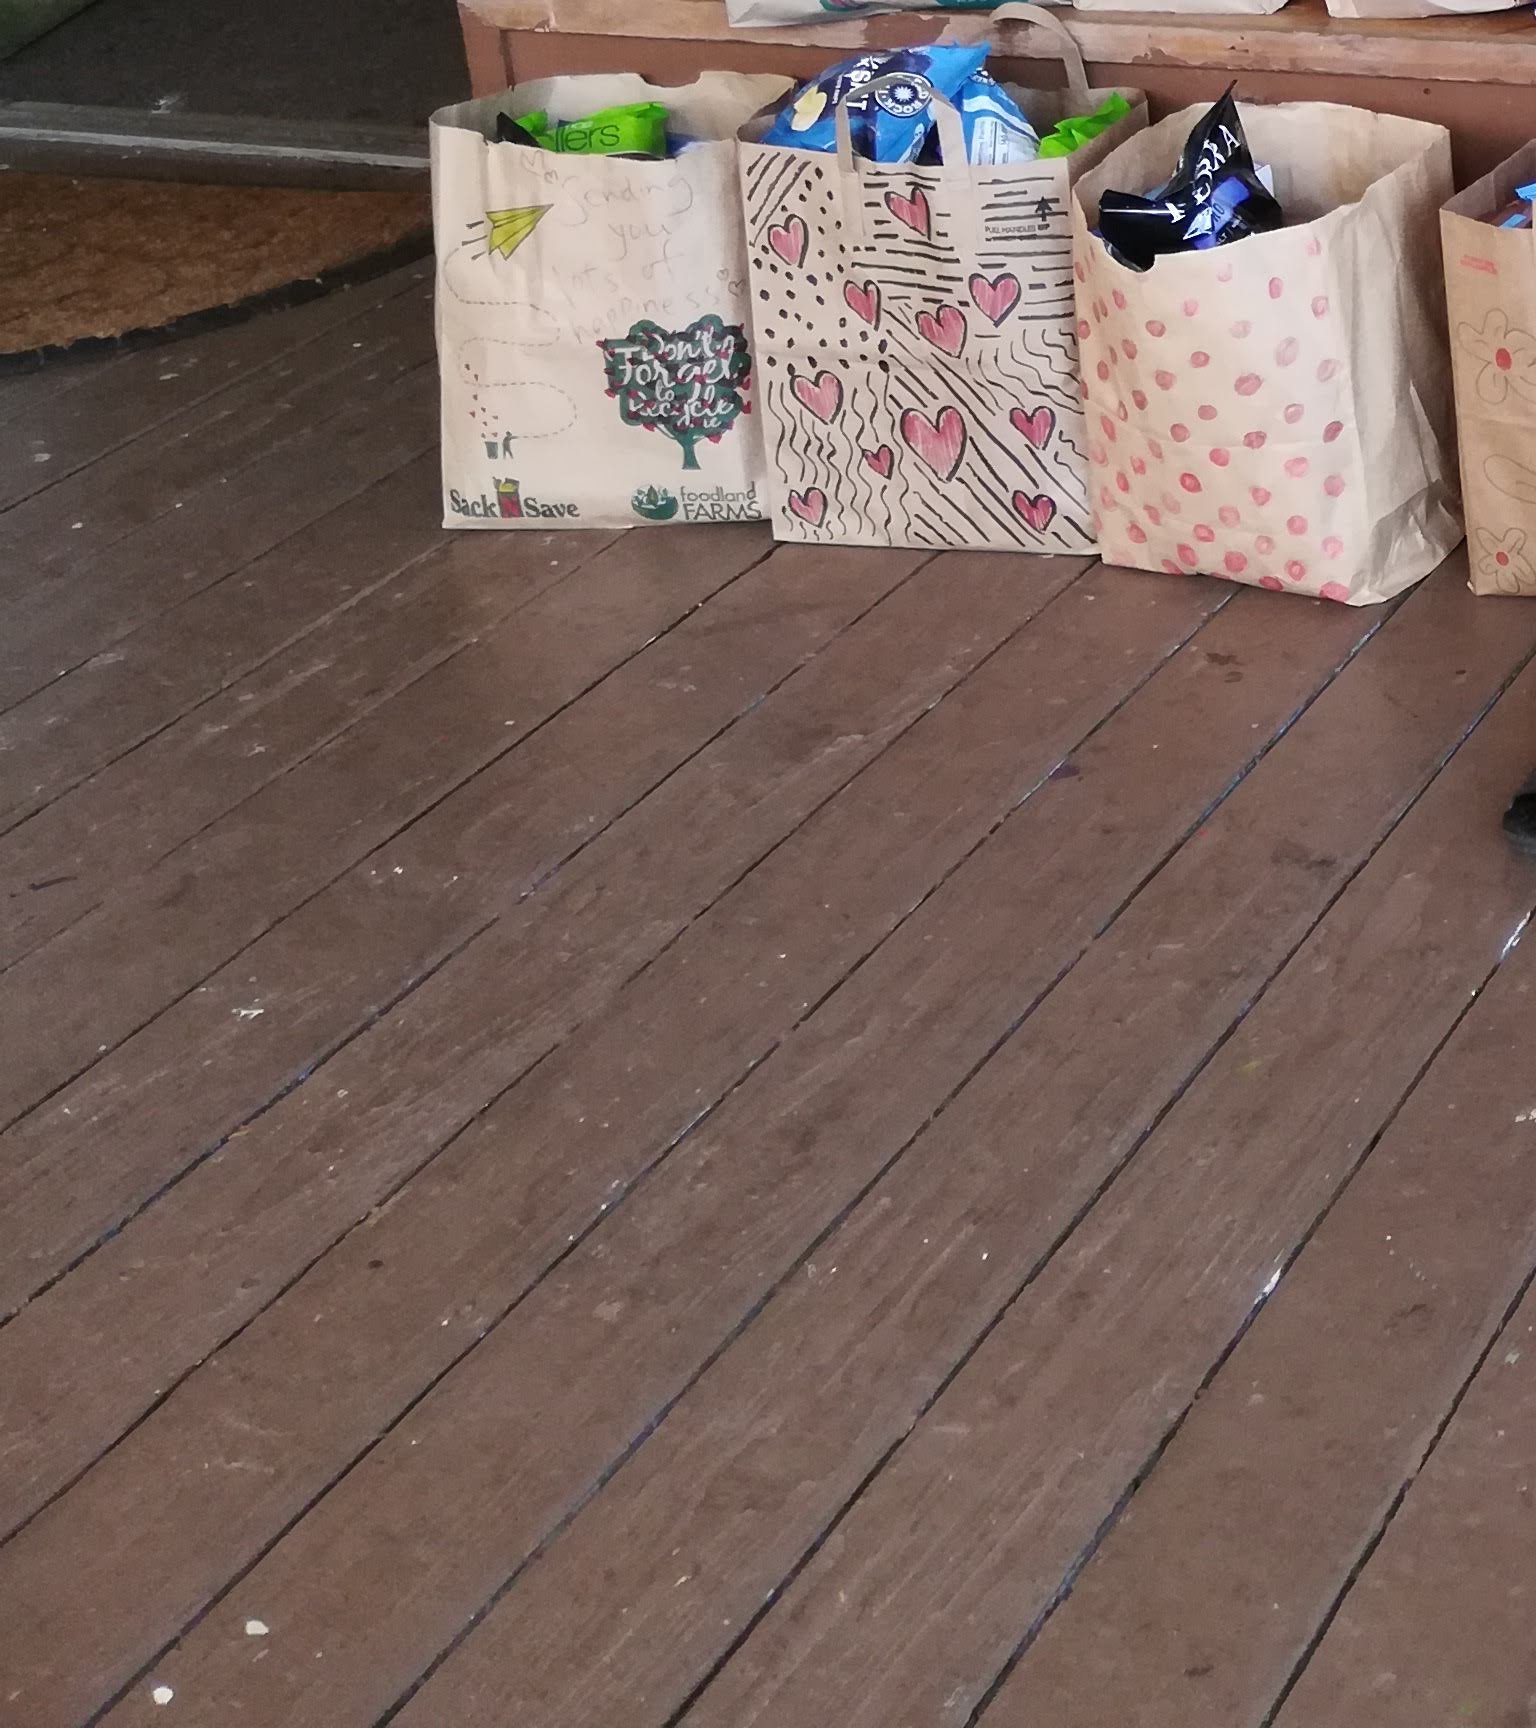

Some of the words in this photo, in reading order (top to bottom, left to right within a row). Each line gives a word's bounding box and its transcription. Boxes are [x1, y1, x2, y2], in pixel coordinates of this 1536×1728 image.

[554, 124, 620, 154] llers
[560, 174, 694, 228] Sending
[607, 223, 673, 262] you
[641, 238, 686, 281] of
[450, 487, 498, 518] Sack
[522, 496, 582, 519] Save
[680, 480, 757, 503] foodland
[682, 500, 763, 522] FARMS
